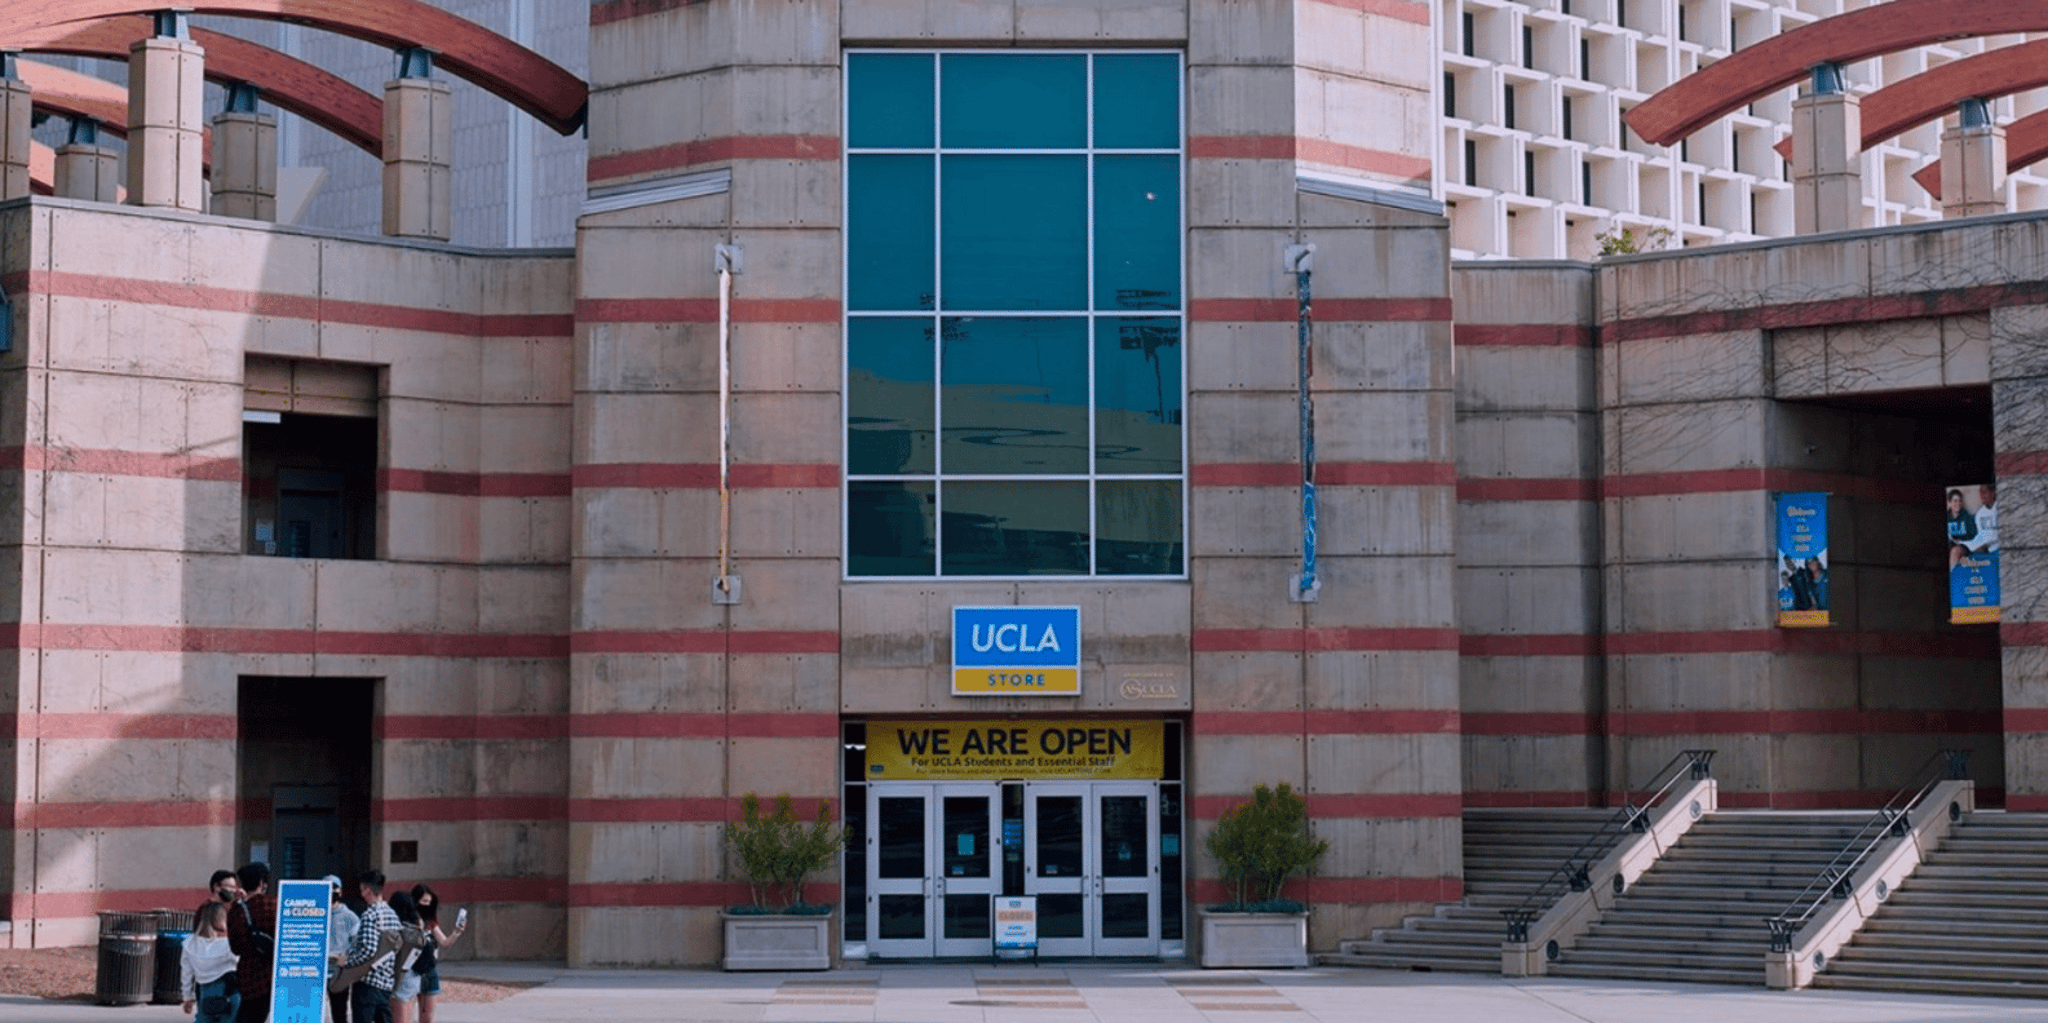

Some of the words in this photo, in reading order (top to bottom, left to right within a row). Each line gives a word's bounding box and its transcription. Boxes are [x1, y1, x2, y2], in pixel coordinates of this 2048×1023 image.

[972, 623, 1061, 652] UCLA
[986, 673, 1045, 687] STORE
[897, 728, 950, 755] WE
[961, 728, 1028, 755] ARE
[1040, 728, 1131, 755] OPEN
[911, 757, 930, 766] For
[932, 757, 961, 767] UCLA
[965, 757, 1012, 767] Students
[1015, 757, 1034, 766] and
[1038, 757, 1085, 767] Essential
[1089, 756, 1115, 766] Staff
[284, 899, 316, 908] CAMPUS
[292, 908, 325, 917] CLOSED
